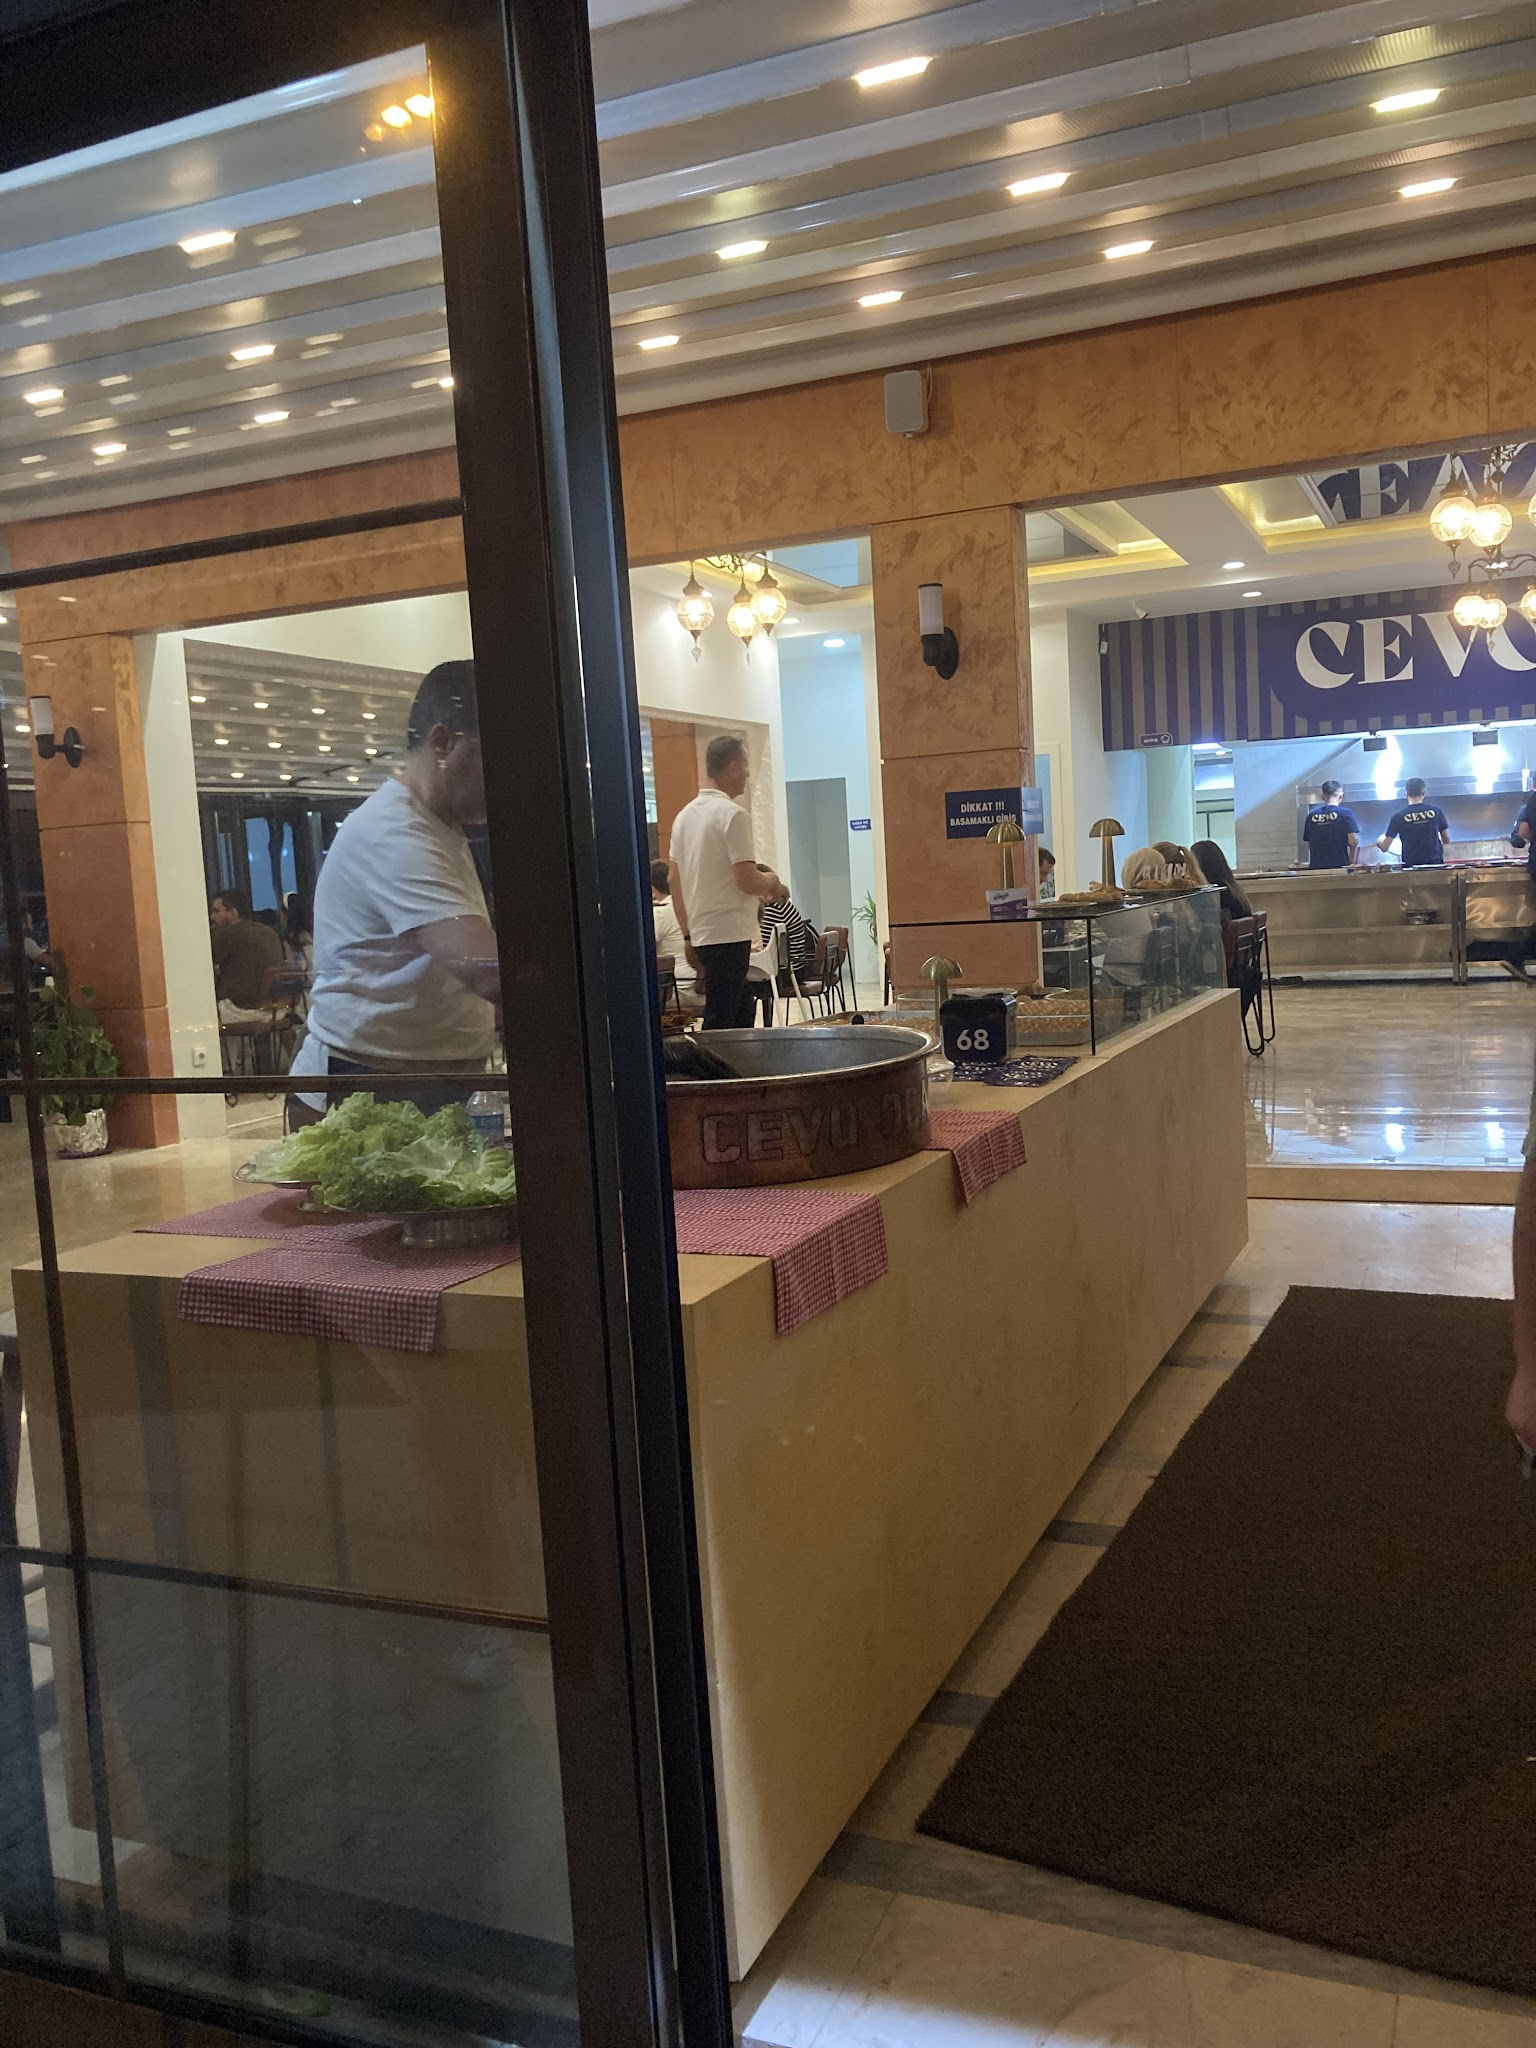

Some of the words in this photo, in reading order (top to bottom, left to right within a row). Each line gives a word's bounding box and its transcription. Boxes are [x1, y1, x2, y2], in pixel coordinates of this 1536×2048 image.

[960, 801, 993, 813] DİKKAT
[995, 801, 1005, 811] !!!
[950, 815, 995, 827] BASAMAKLI
[1404, 809, 1436, 823] CEVO
[956, 1028, 990, 1051] 68
